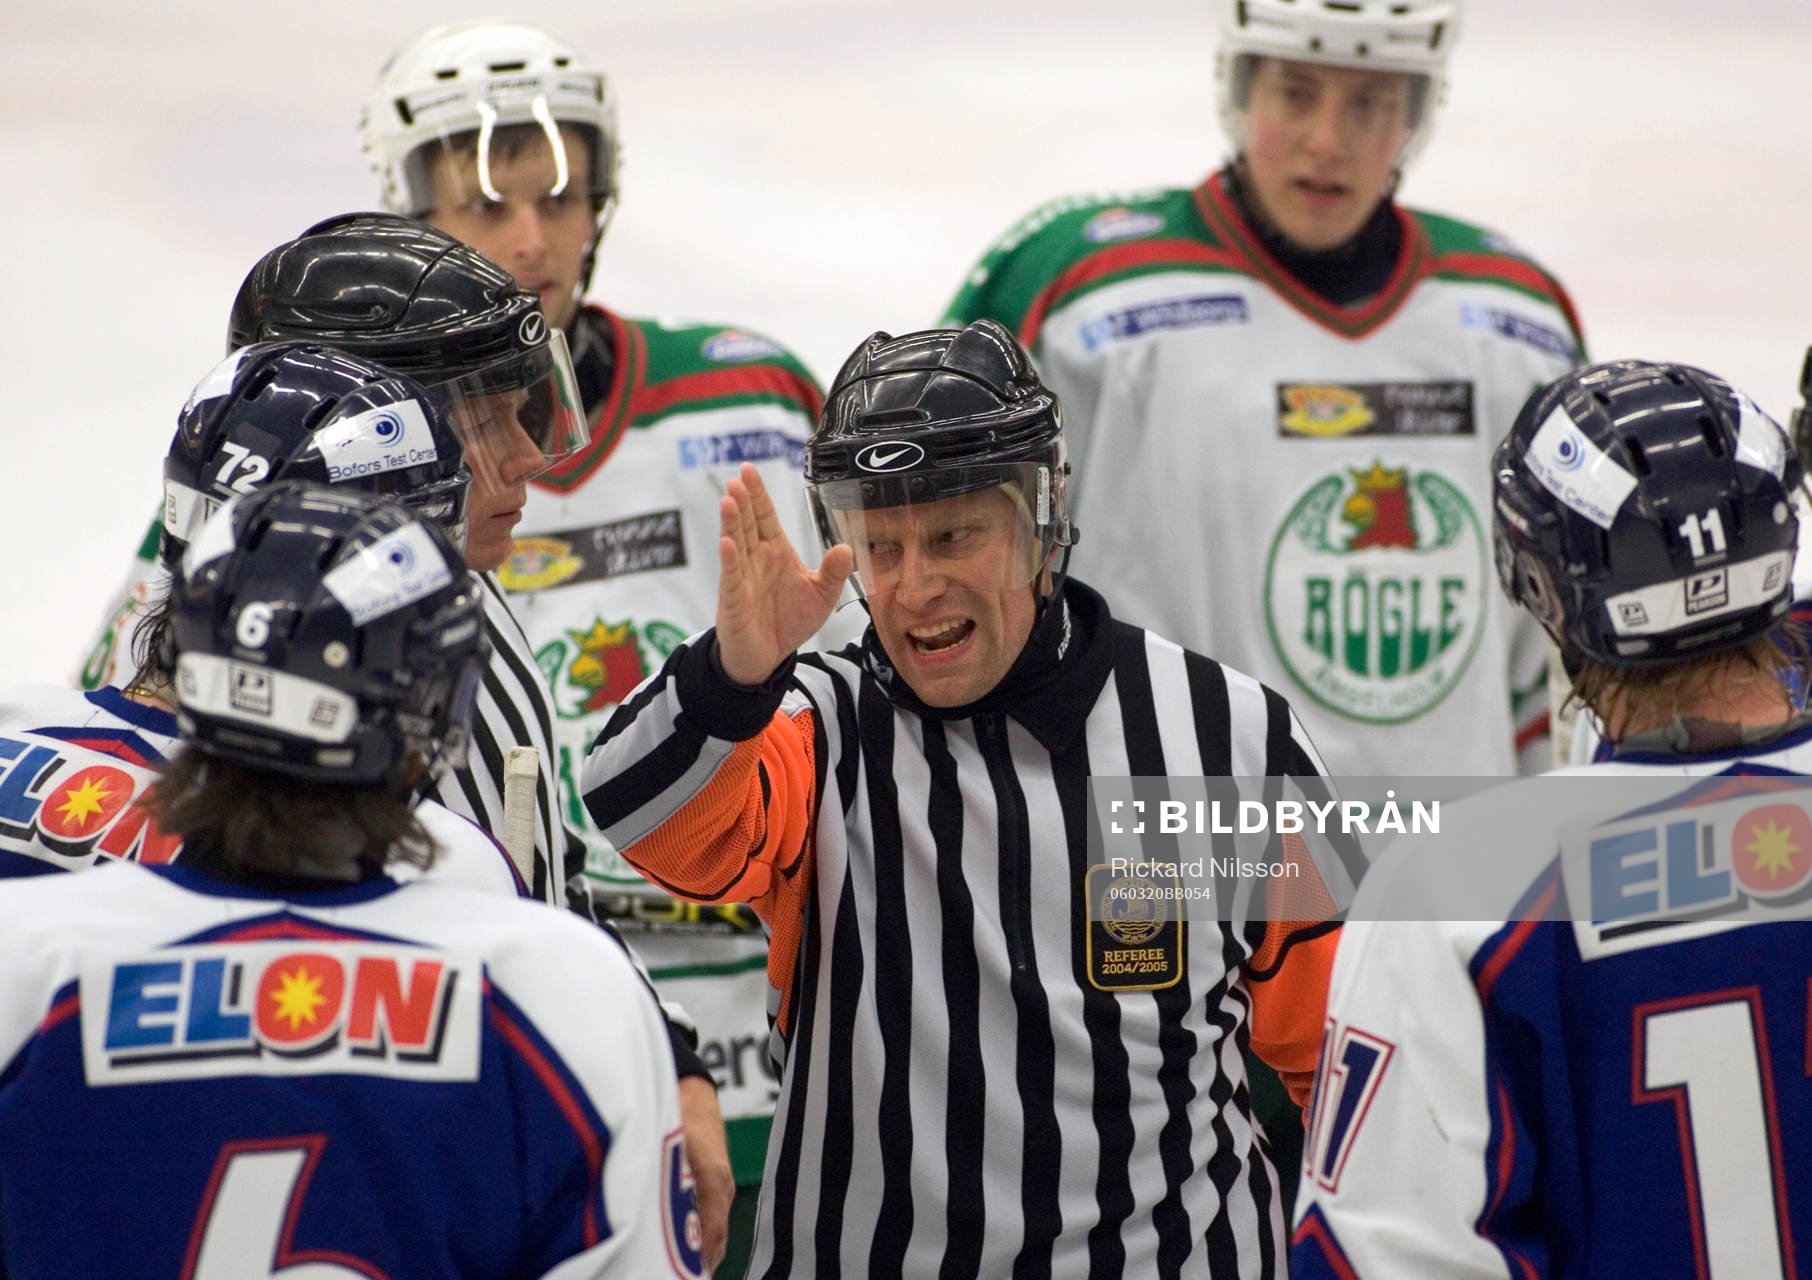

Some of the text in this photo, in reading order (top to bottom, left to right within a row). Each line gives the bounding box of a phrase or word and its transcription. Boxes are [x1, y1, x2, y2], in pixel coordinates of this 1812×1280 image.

[215, 441, 270, 495] 72
[327, 460, 381, 479] Bofors
[384, 453, 407, 467] Test
[1679, 508, 1727, 558] 11
[236, 601, 274, 648] 6
[1305, 567, 1466, 679] RÖGLE
[1102, 961, 1168, 974] 2004/2005
[1104, 949, 1164, 962] REFEREE
[104, 953, 446, 1052] ELON
[1632, 984, 1812, 1280] 1
